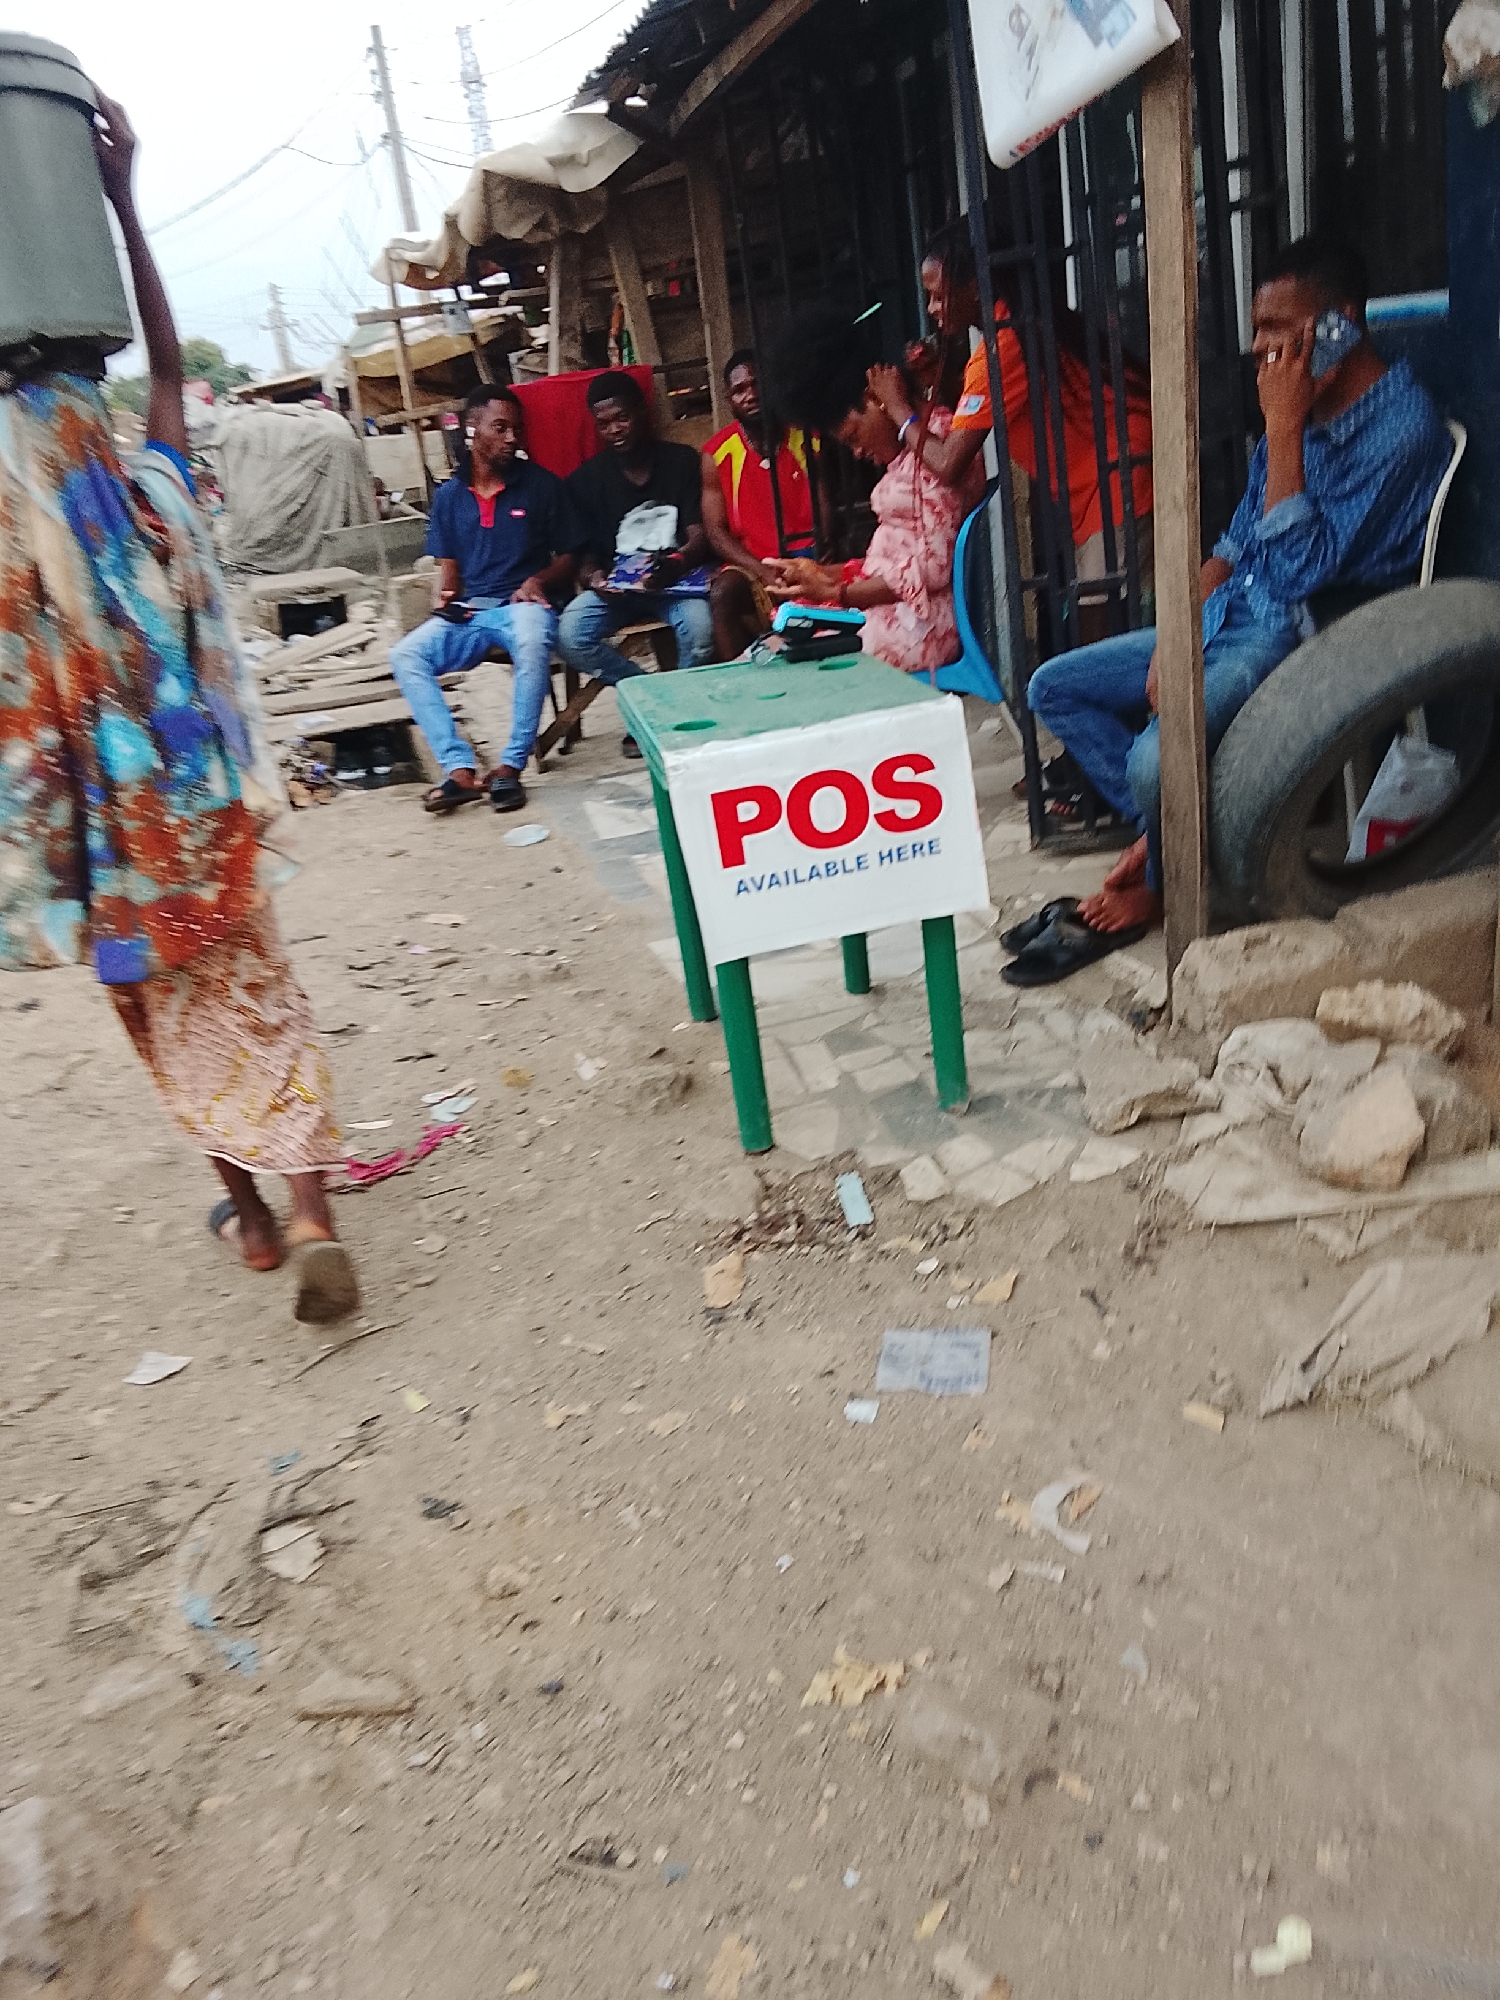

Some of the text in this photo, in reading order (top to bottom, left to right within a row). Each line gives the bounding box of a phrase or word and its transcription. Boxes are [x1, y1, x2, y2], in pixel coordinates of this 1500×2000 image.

[710, 753, 943, 869] POS
[736, 838, 942, 896] AVAILABLE HERE
